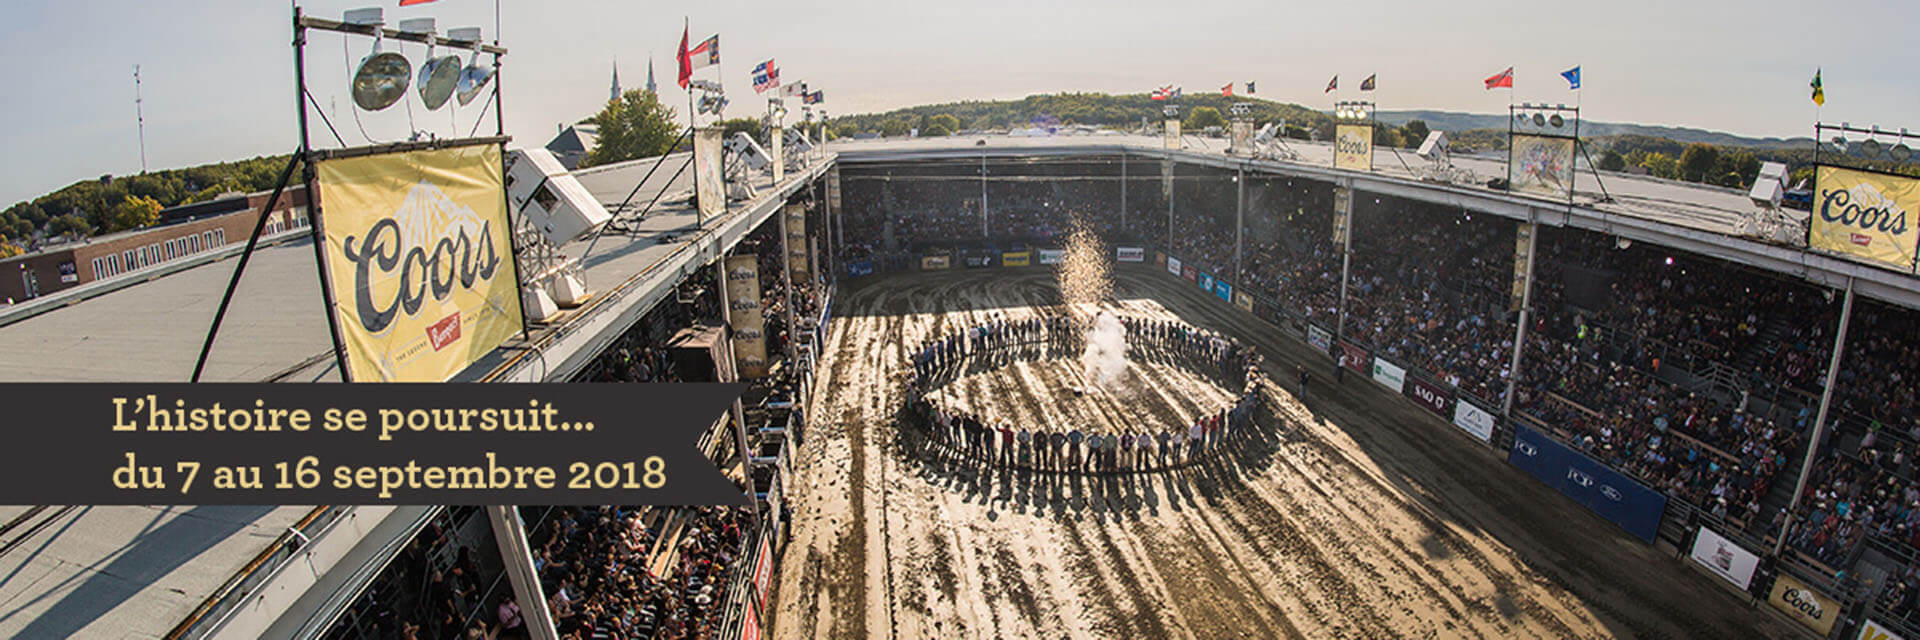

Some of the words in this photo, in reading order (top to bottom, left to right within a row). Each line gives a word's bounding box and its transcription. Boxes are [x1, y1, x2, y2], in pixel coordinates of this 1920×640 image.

[1338, 134, 1369, 155] Coors
[1821, 189, 1908, 236] Coors
[344, 218, 500, 333] Coors
[1782, 585, 1824, 620] Coors
